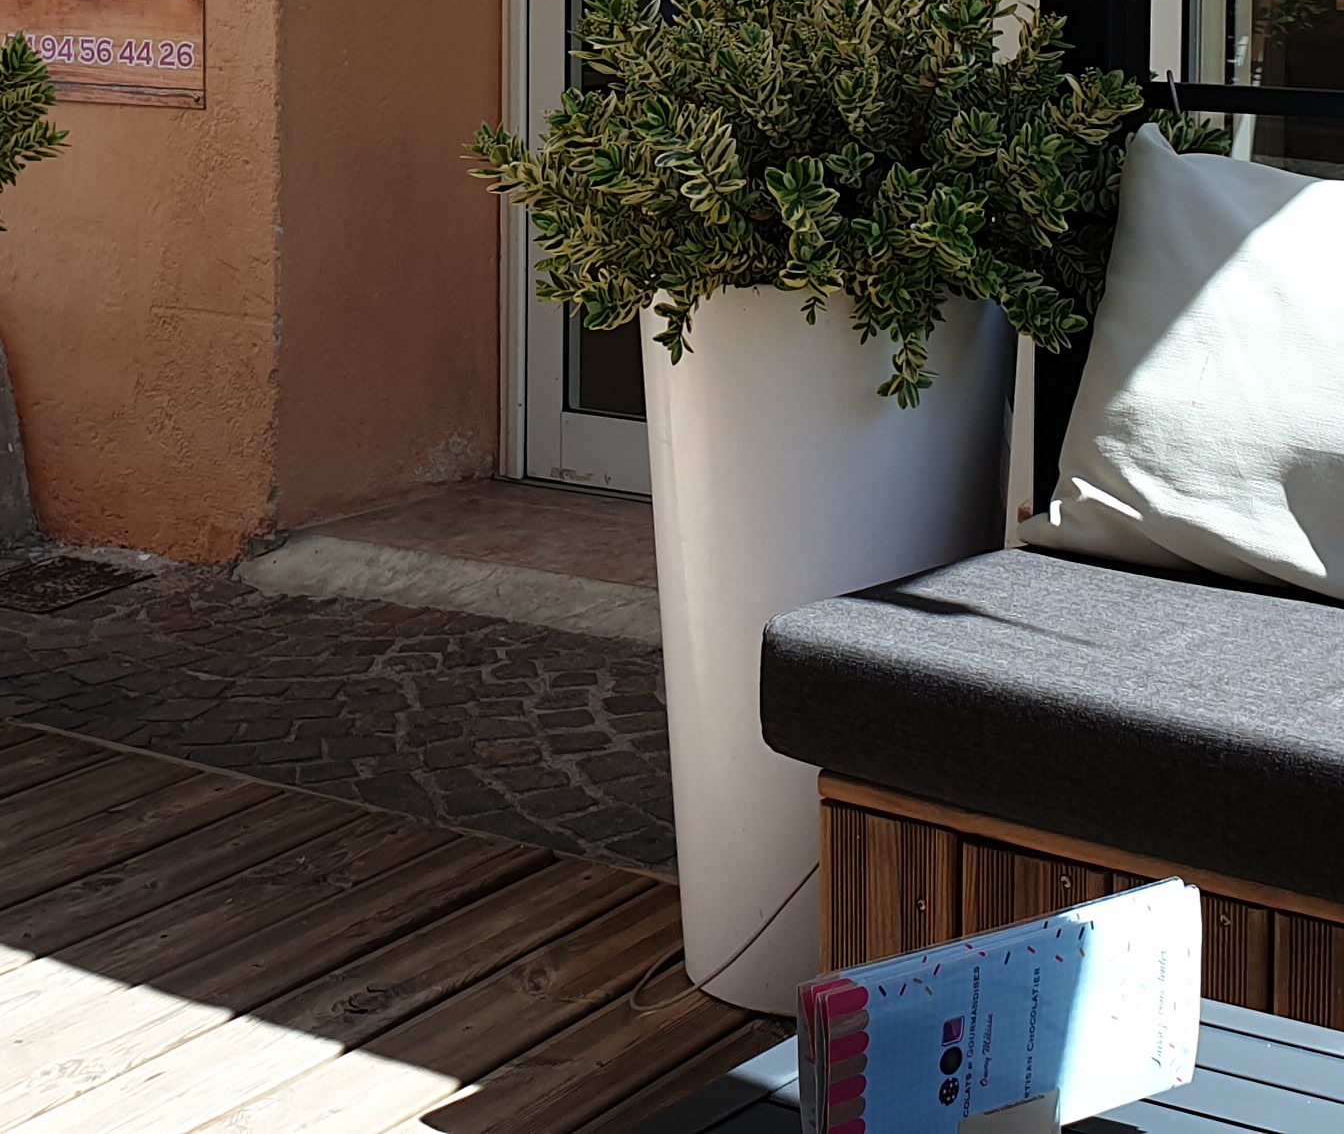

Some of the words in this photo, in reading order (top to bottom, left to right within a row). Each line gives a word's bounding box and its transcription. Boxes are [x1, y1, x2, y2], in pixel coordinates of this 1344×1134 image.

[41, 35, 74, 63] 94
[79, 38, 113, 65] 56
[118, 39, 153, 66] 44
[158, 41, 194, 69] 26
[966, 966, 980, 1058] GOURMANDISES
[1026, 967, 1041, 1052] CHOCOLATIER
[1024, 1056, 1033, 1098] RTISAN
